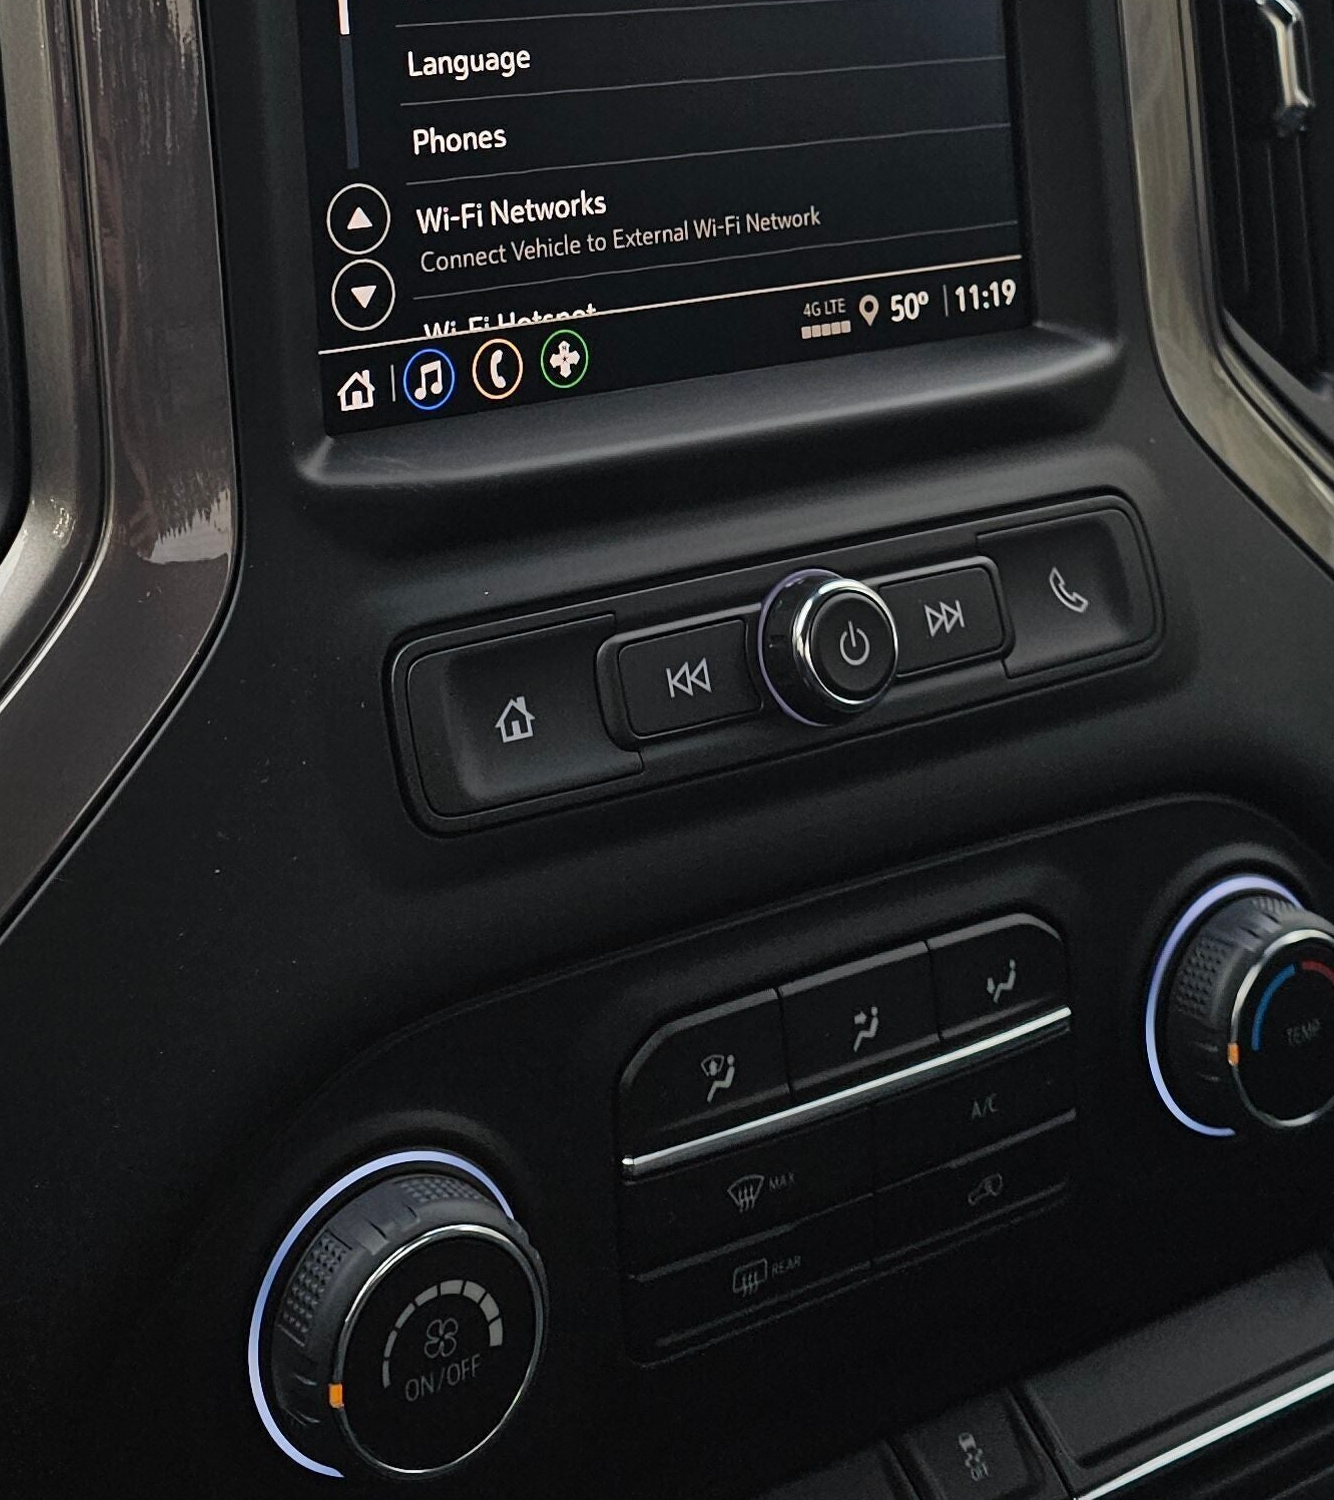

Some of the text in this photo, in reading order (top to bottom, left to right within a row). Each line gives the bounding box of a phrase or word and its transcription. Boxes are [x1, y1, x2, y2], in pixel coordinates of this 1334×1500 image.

[407, 47, 531, 81] Language
[413, 123, 507, 156] Phones
[416, 189, 607, 235] Wi-Fi Networks
[420, 205, 821, 273] Connect Vehicle to External Wi-Fi Network
[803, 297, 847, 318] 4G LTE
[955, 278, 1017, 313] 11:19
[423, 316, 490, 338] WiFi
[971, 1092, 999, 1120] A/C
[769, 1171, 796, 1192] MAX
[771, 1254, 802, 1279] REAR
[405, 1352, 483, 1402] ON/OFF
